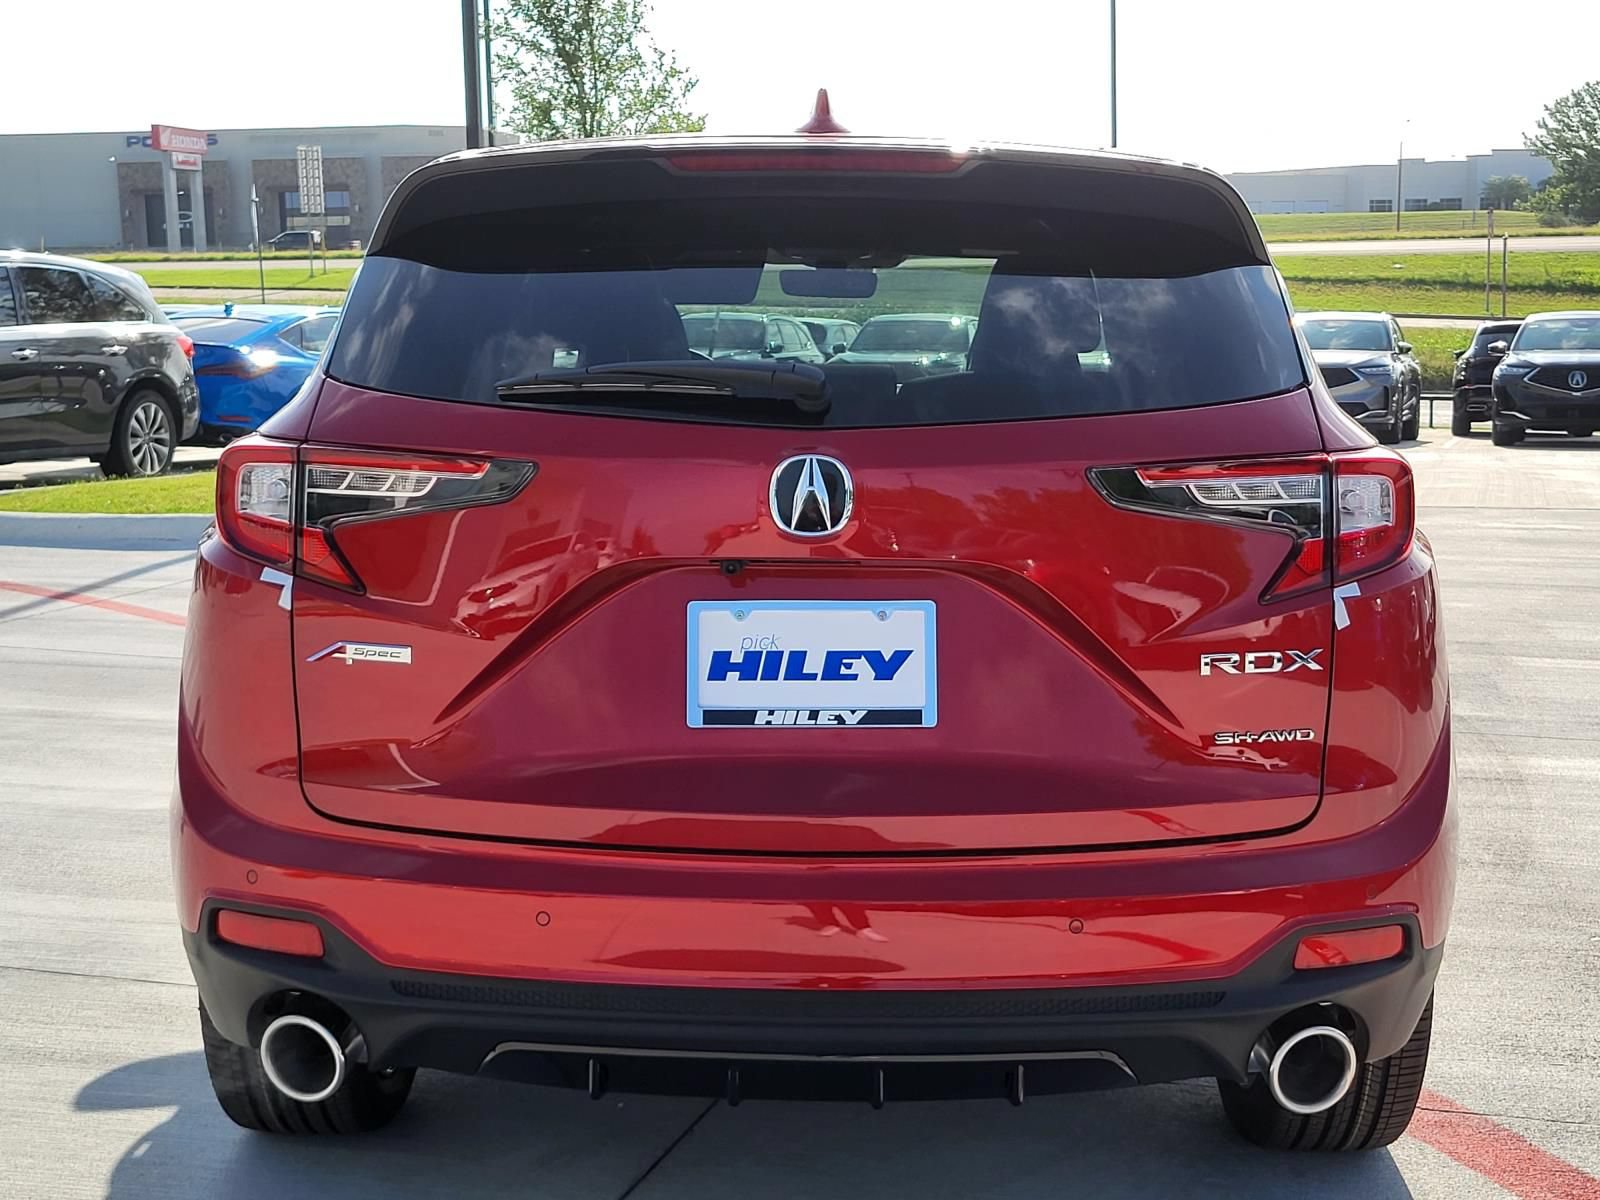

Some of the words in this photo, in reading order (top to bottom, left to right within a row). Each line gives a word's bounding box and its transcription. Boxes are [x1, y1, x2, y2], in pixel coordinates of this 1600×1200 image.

[171, 134, 207, 150] HONDA
[740, 634, 782, 653] pick
[707, 650, 914, 681] HILEY
[1200, 648, 1324, 676] RDX
[754, 710, 868, 725] HILEY
[1214, 729, 1315, 745] SH-AWD
